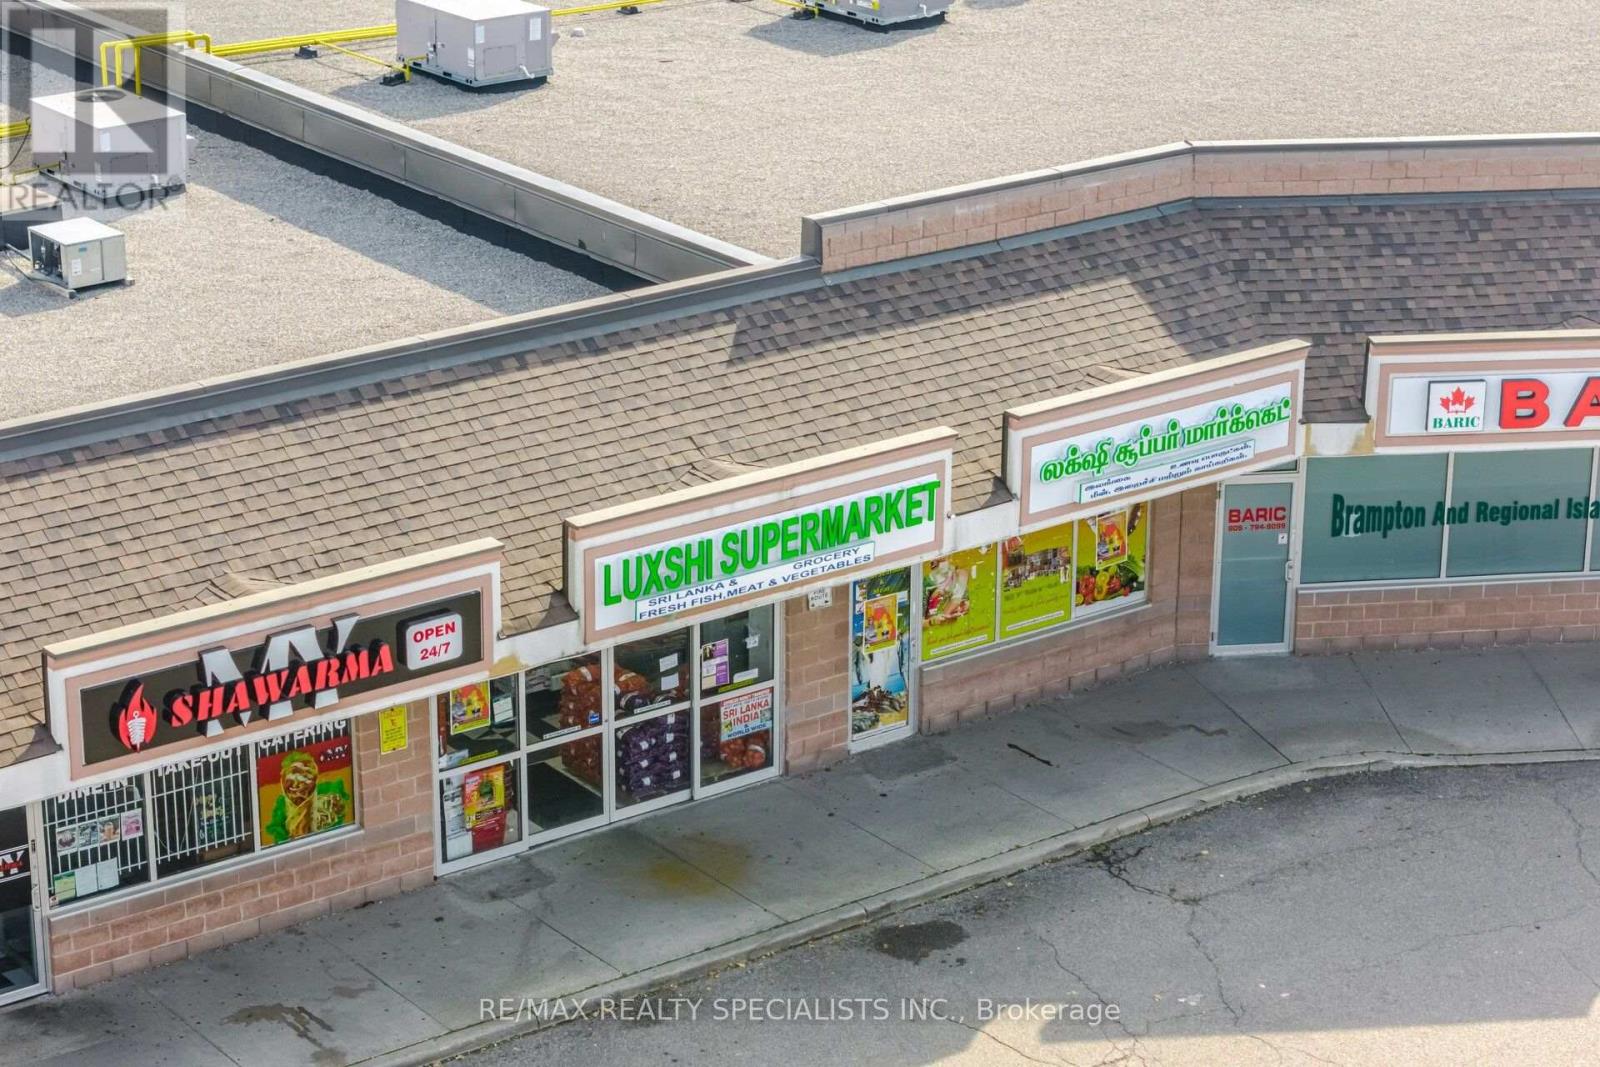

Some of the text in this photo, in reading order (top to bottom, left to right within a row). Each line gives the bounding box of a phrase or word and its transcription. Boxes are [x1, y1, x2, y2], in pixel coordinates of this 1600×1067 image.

[1432, 415, 1480, 429] BARIC
[1228, 506, 1286, 523] BARIC
[1331, 493, 1426, 539] Brampton
[1432, 501, 1470, 525] And
[1476, 499, 1559, 526] Regional
[603, 480, 941, 606] LUXSHI SUPERMARKET
[792, 547, 861, 570] GROCERY
[639, 602, 687, 620] FRESH
[768, 577, 778, 587] &
[782, 554, 872, 583] VEGETABLES
[648, 578, 738, 607] SRI LANKA &
[413, 621, 456, 643] OPEN
[420, 641, 451, 660] 24/7
[171, 643, 394, 728] SHAWARMA
[723, 708, 738, 720] SRI
[740, 698, 769, 714] LANKA
[733, 711, 759, 726] INDIA
